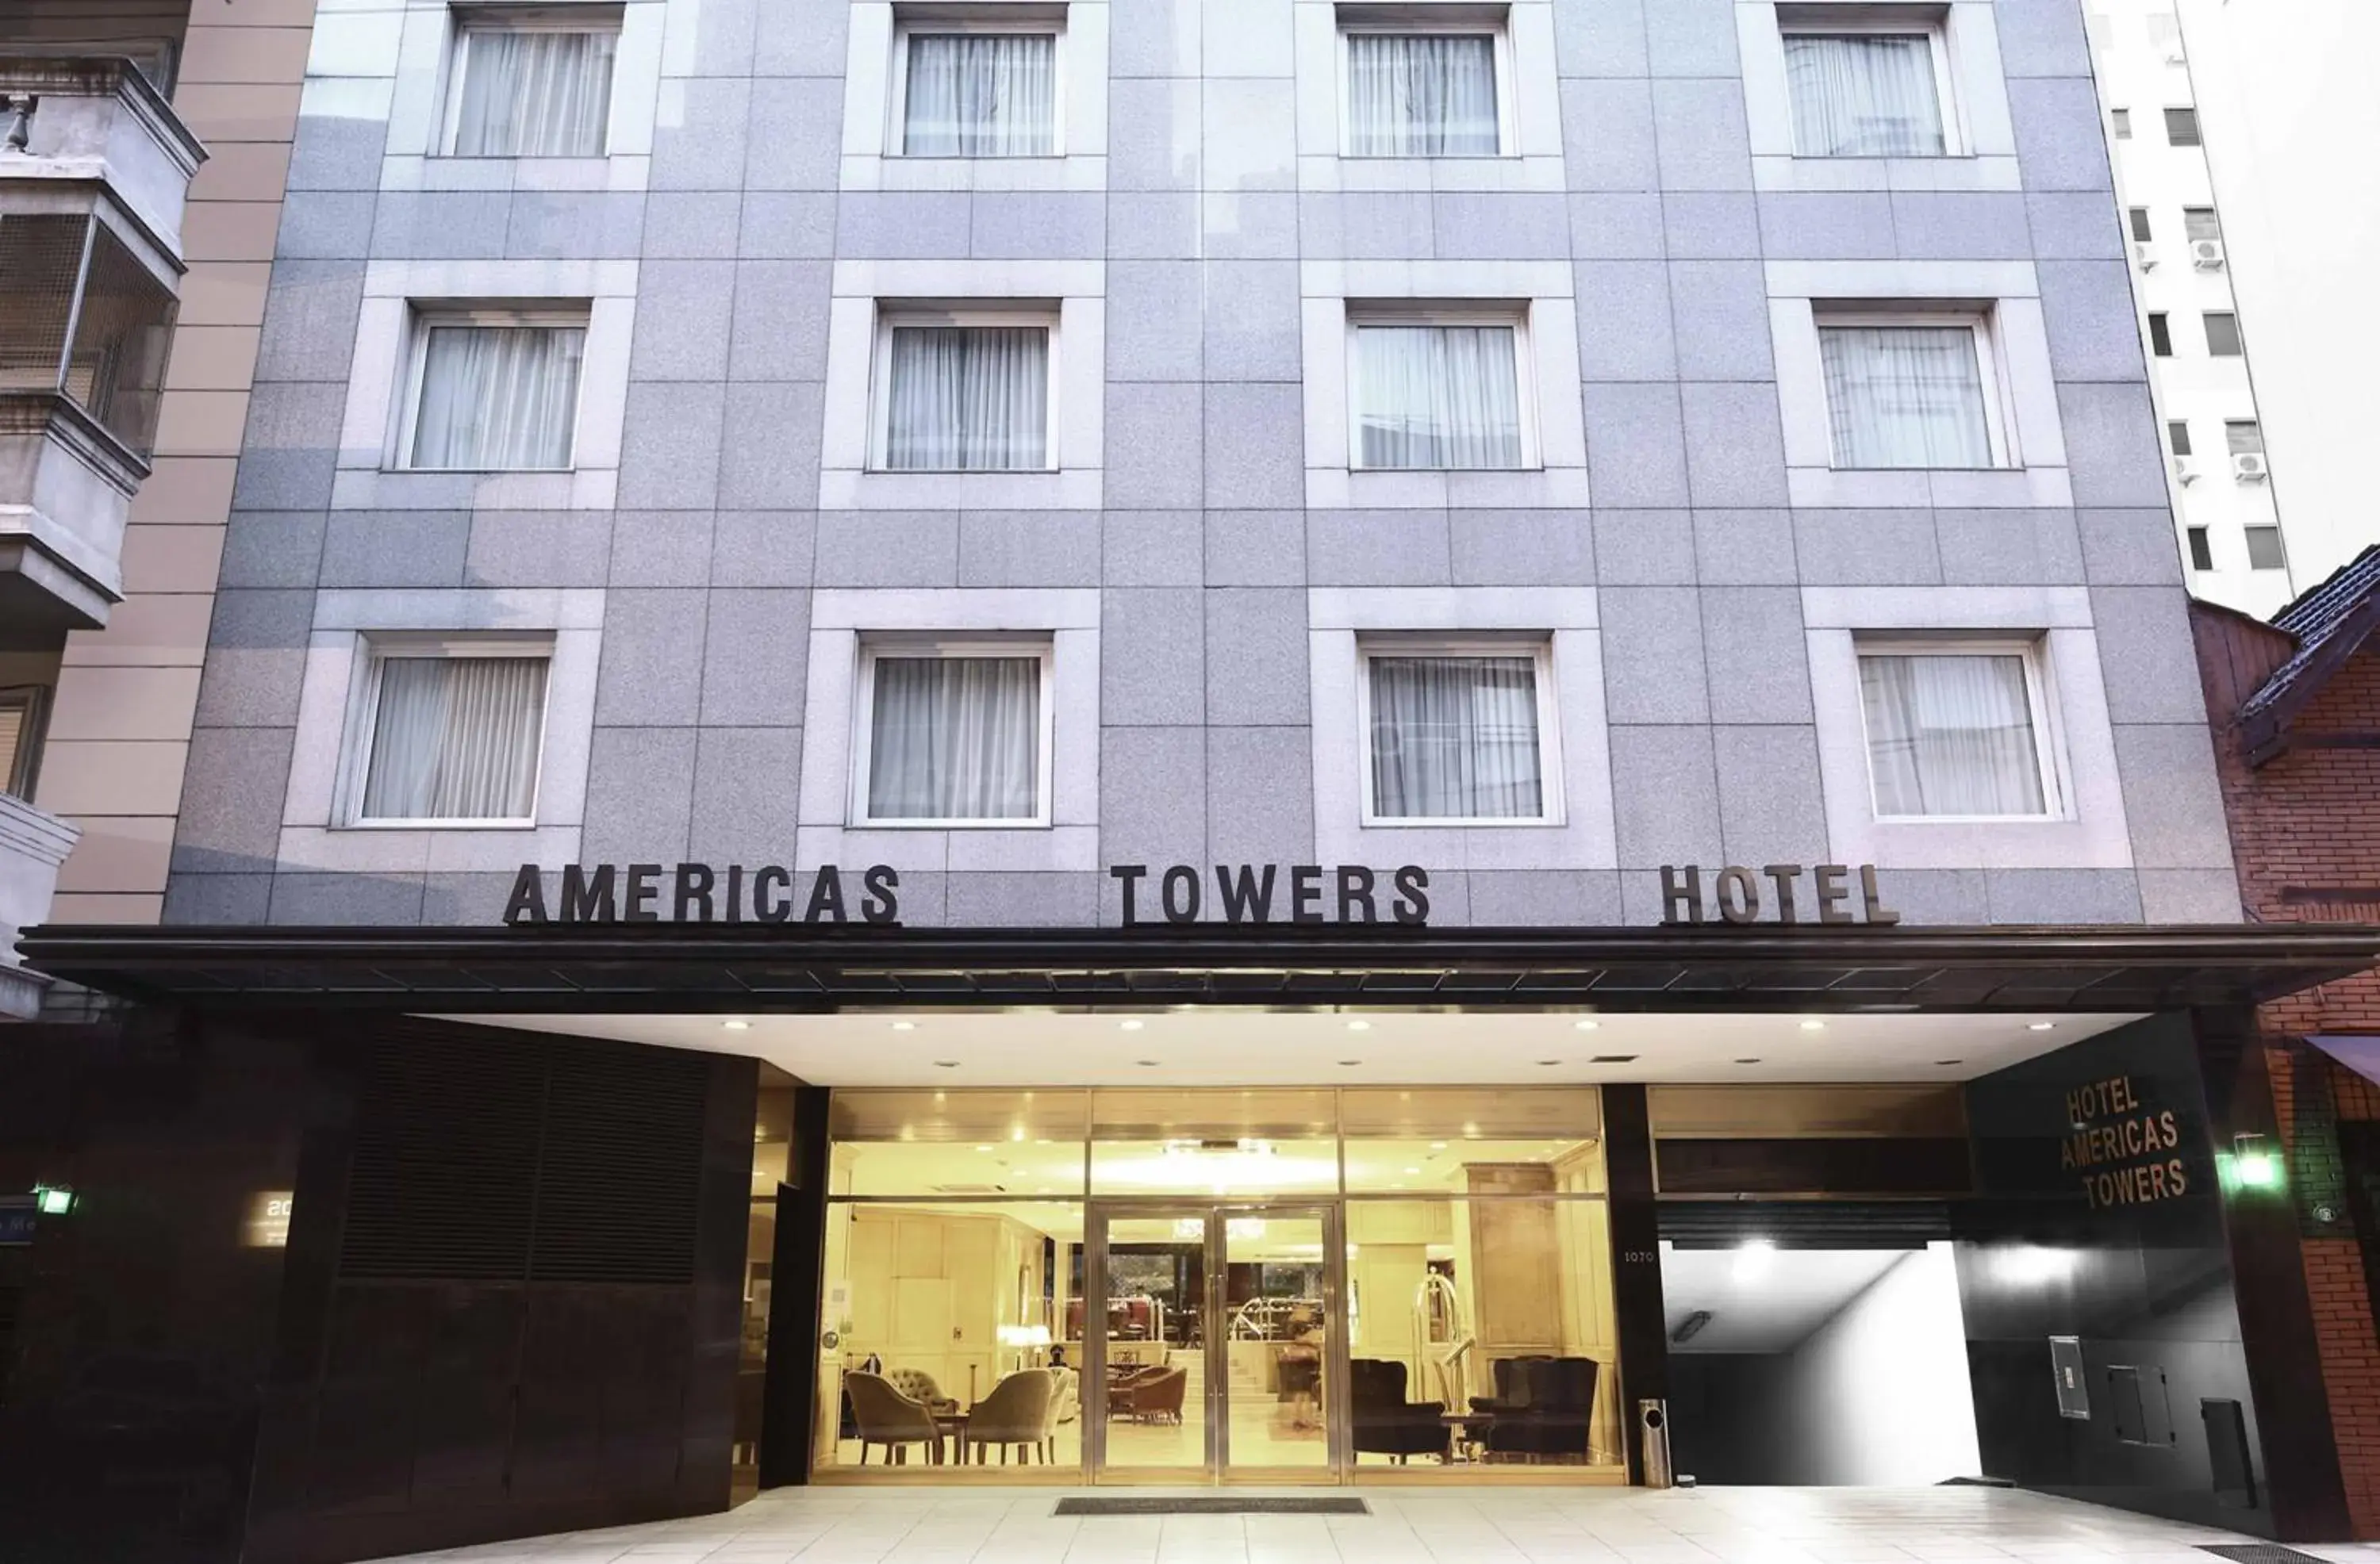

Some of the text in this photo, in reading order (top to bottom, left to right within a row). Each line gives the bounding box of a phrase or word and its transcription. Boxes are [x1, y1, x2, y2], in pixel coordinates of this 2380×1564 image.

[503, 864, 1900, 925] AMERICAS TOWERS HOTEL
[2067, 1075, 2139, 1124] HOTEL
[2062, 1110, 2178, 1169] AMERICAS
[2082, 1159, 2186, 1209] TOWERS
[1625, 1252, 1654, 1263] 1070
